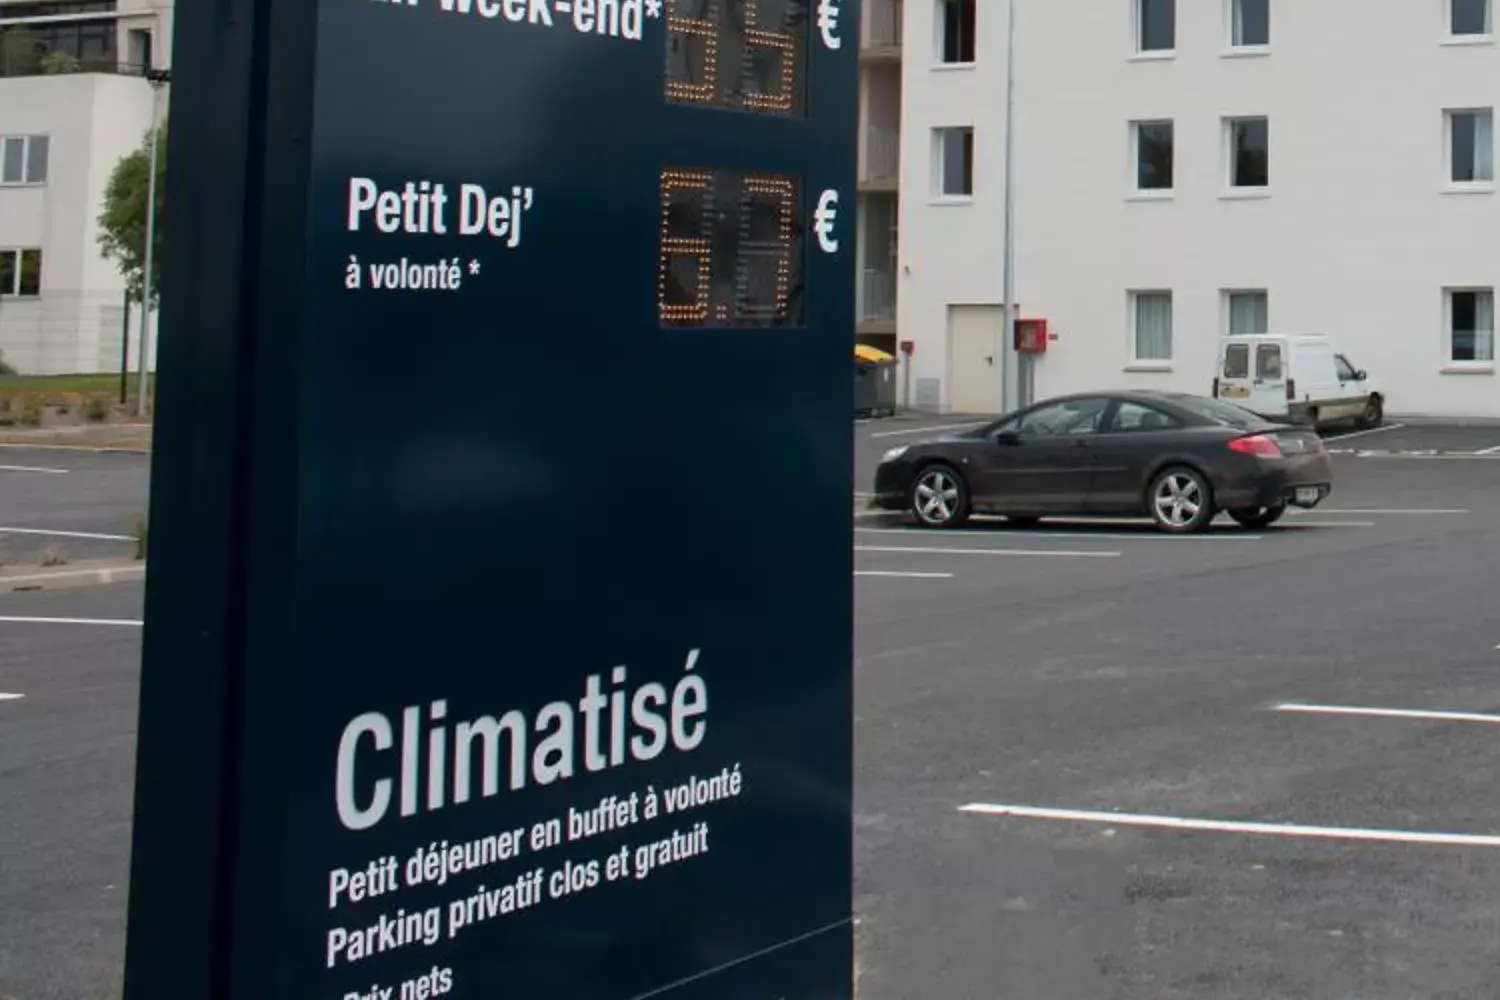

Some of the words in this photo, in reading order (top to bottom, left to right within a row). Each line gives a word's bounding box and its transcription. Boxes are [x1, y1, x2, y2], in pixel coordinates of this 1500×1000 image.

[345, 255, 361, 290] à
[369, 257, 461, 290] volonté
[347, 176, 447, 236] Petit
[813, 189, 839, 253] €
[335, 648, 708, 832] Climatisé
[326, 906, 442, 968] Parking
[448, 873, 543, 938] privatif
[548, 858, 600, 900] clos
[605, 844, 630, 881] et
[635, 821, 710, 876] gratuit
[328, 855, 399, 908] Petit
[405, 822, 525, 888] déjeuner
[530, 818, 561, 851] en
[568, 791, 639, 840] buffet
[644, 784, 658, 820] à
[664, 762, 743, 812] volonté
